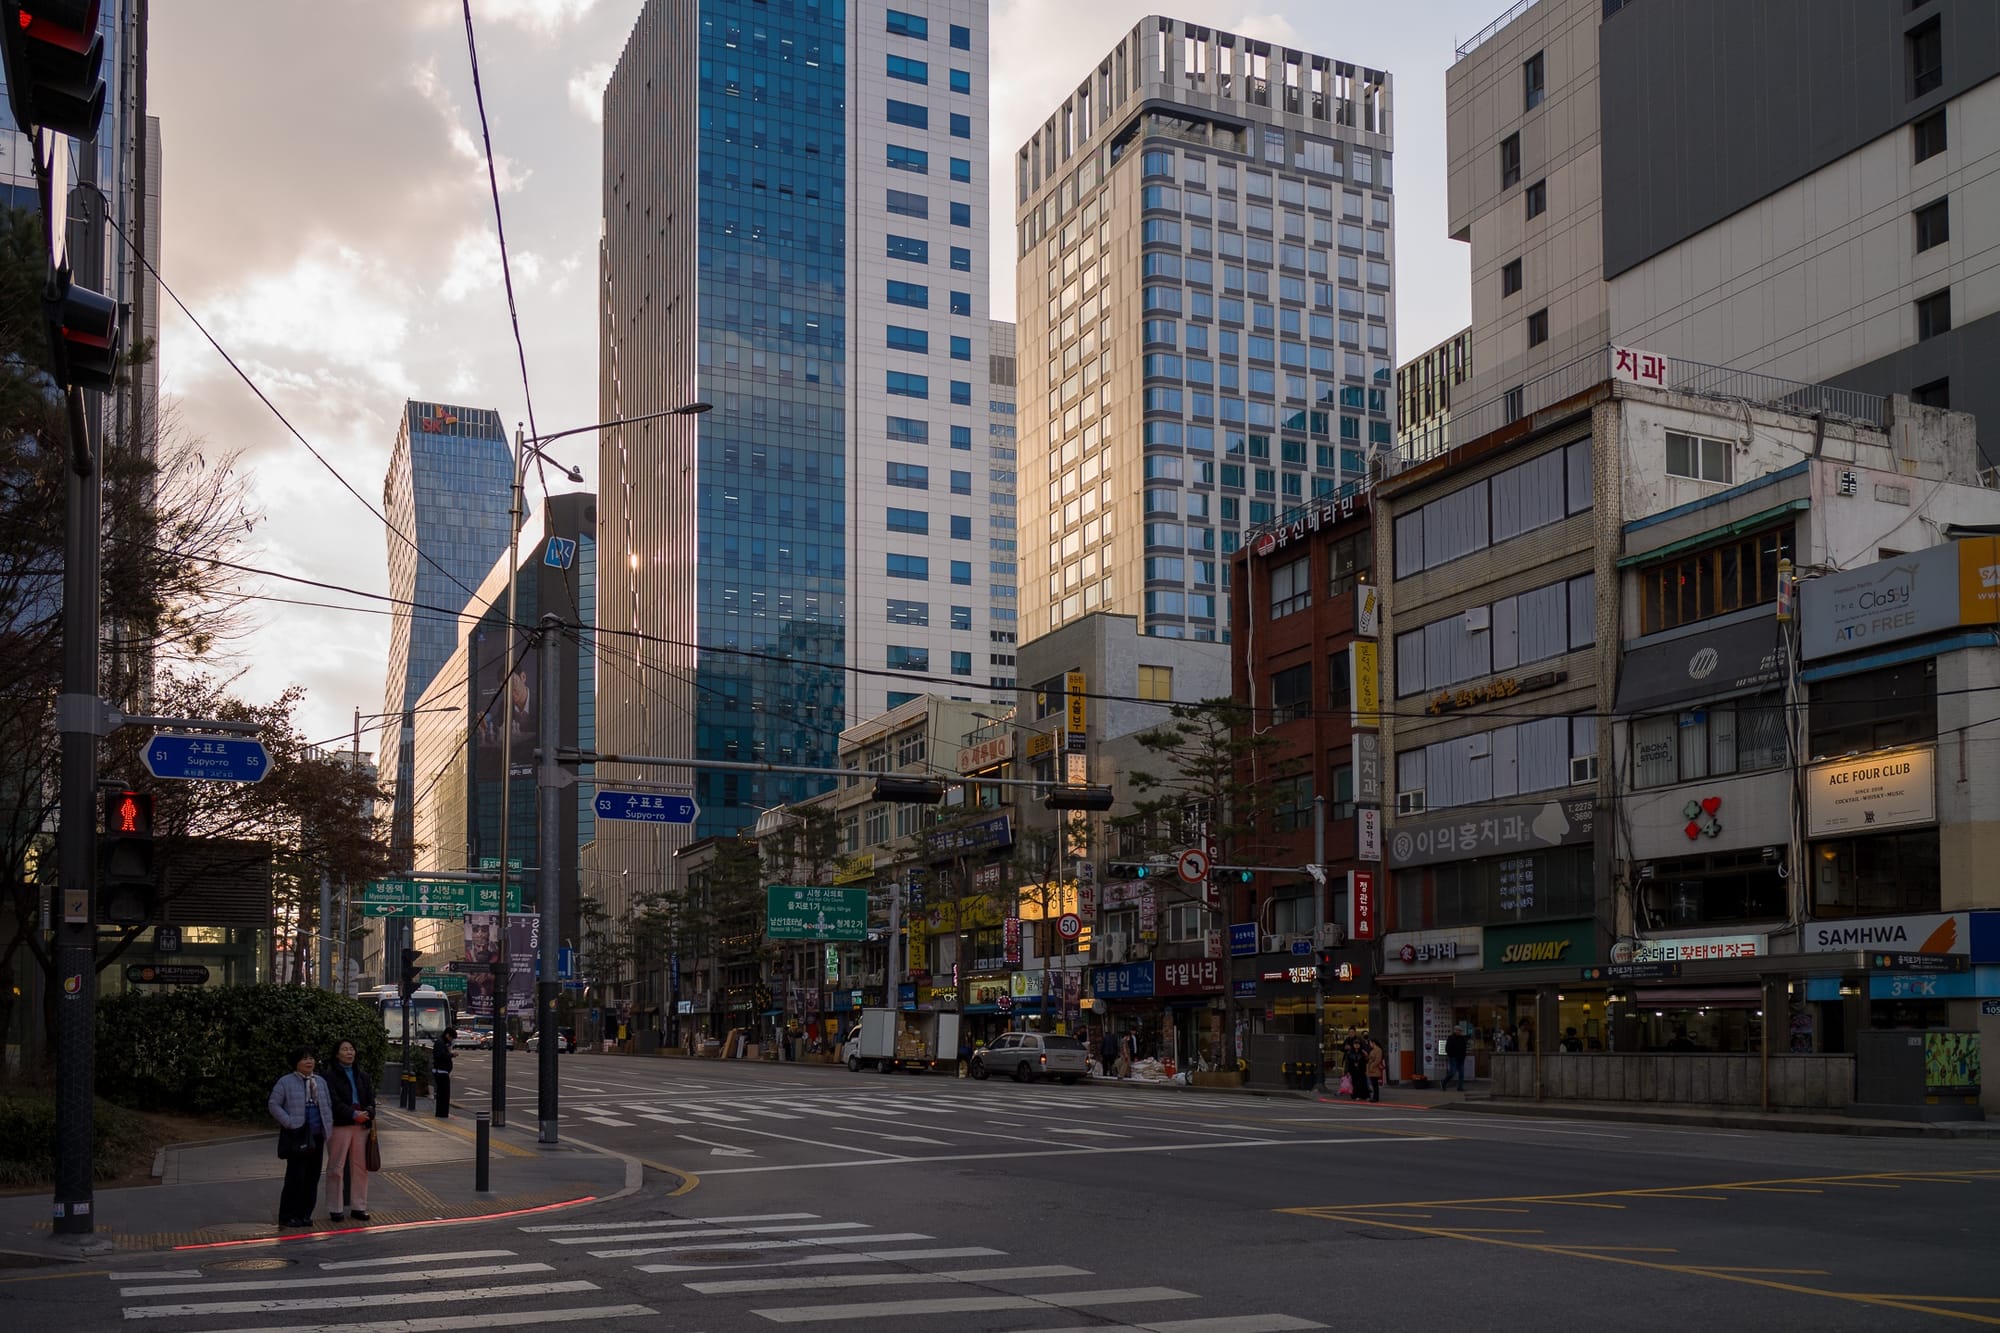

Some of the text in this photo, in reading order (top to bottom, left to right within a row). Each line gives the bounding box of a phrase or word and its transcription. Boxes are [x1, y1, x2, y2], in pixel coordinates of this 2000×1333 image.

[1616, 349, 1666, 385] 치과
[423, 419, 442, 432] SK
[1277, 495, 1353, 548] 유신메라민
[1360, 588, 1376, 632] SUBWAY
[1836, 623, 1866, 643] ATO
[1872, 611, 1915, 634] FREE
[188, 741, 228, 754] 수표로
[156, 751, 168, 760] 51
[187, 756, 229, 767] Supyo-ro
[246, 756, 259, 766] 55
[1640, 751, 1668, 762] STUDIO
[1362, 760, 1377, 796] 치과
[1829, 762, 1910, 785] ACE FOUR CLUB
[599, 800, 611, 810] 53
[627, 795, 664, 808] 수표로
[1835, 796, 1860, 805] COCKTAIL
[626, 809, 665, 820] Supyo-ro
[680, 805, 691, 815] 57
[1366, 820, 1374, 849] 김가네
[1417, 815, 1524, 855] 이의홍치과
[1582, 823, 1593, 833] 2F
[432, 884, 449, 895] 시청
[1082, 888, 1095, 918] 바둑
[1359, 881, 1368, 917] 정관장
[787, 902, 820, 911] 을지로1가
[837, 920, 863, 929] 청계2가
[1062, 919, 1077, 933] 50
[1818, 925, 1907, 945] SAMHWA
[1416, 942, 1457, 960] 김가네
[1502, 939, 1571, 964] SUBWAY
[1680, 942, 1755, 961] 황태해장국
[1165, 961, 1218, 986] 타일나라
